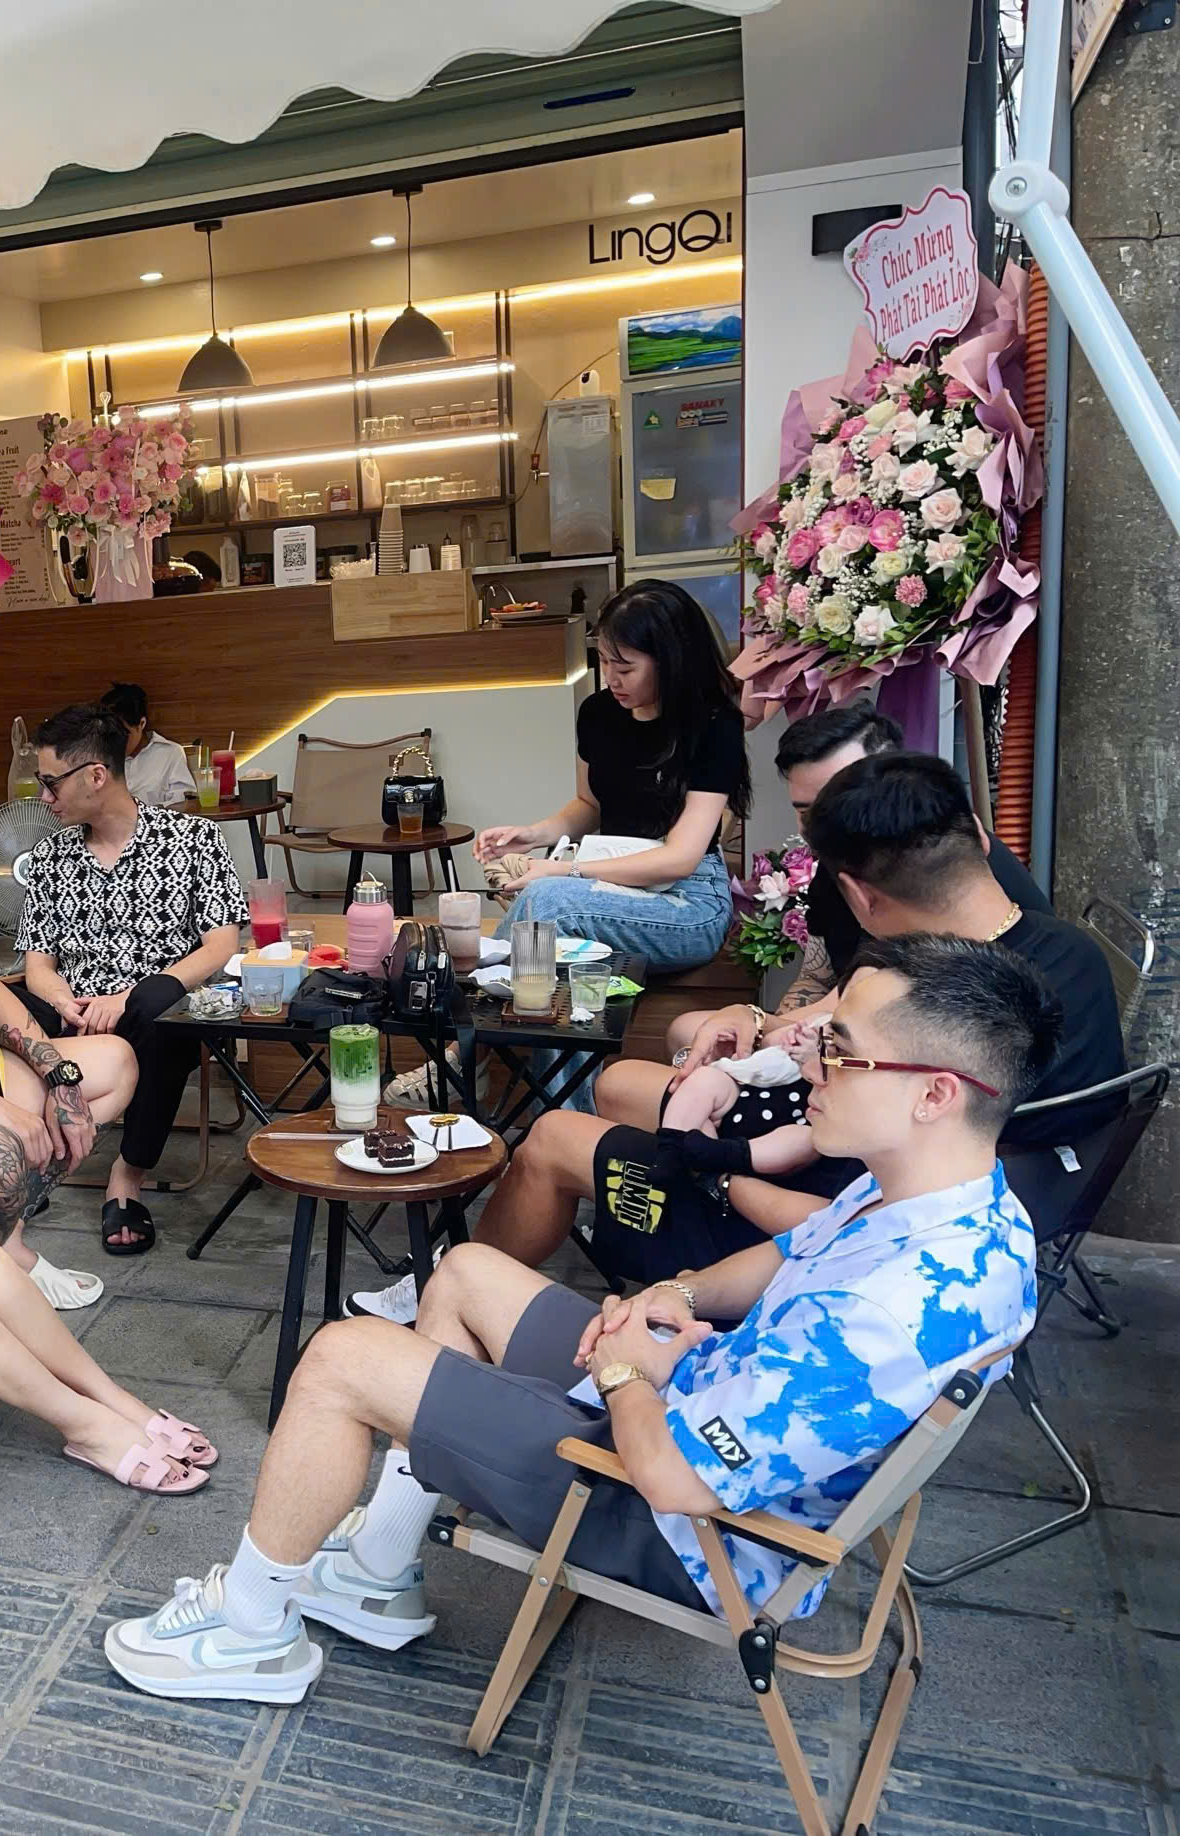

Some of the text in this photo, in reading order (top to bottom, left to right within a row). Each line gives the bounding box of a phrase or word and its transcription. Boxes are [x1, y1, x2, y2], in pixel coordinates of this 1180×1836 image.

[881, 223, 955, 288] Chúc Mừng
[880, 297, 904, 341] Phát
[903, 285, 923, 328] Tài
[922, 271, 950, 319] Phát
[6, 445, 20, 455] Fruit
[0, 519, 21, 529] Matcha
